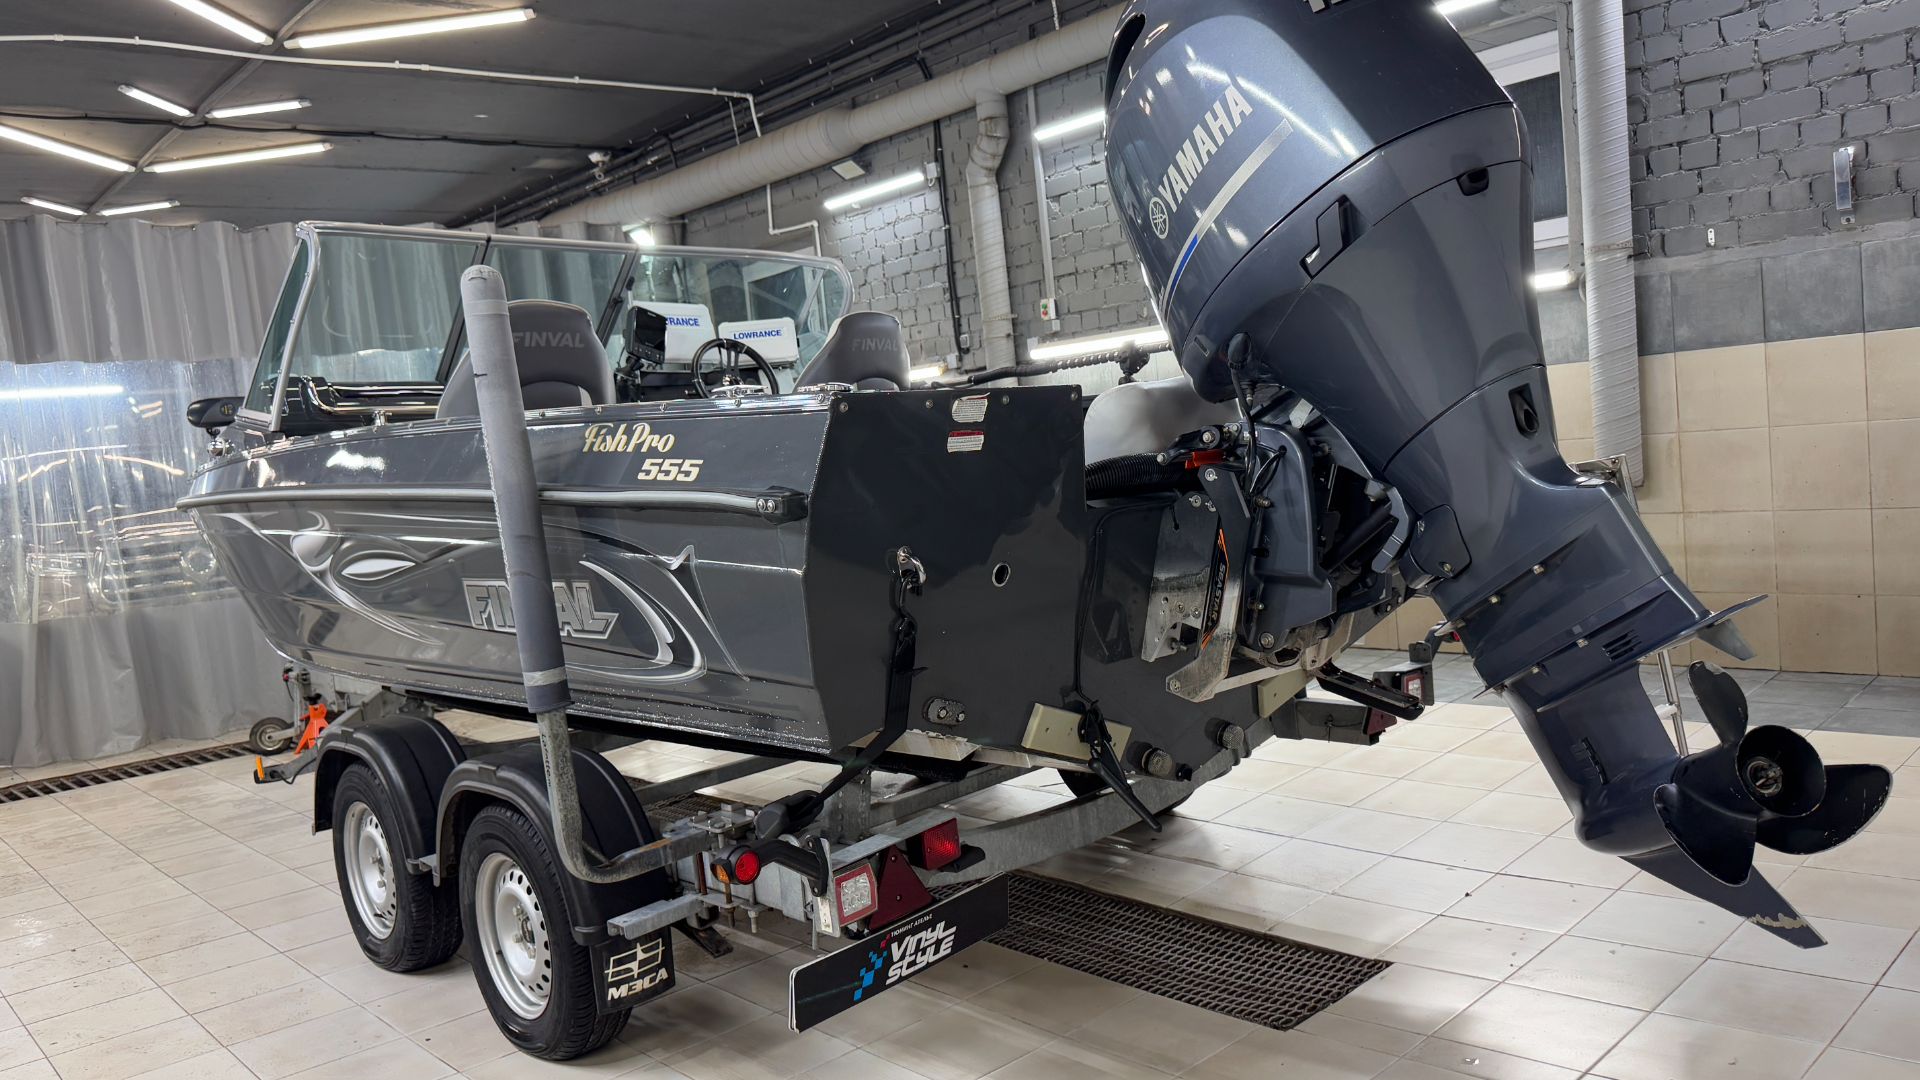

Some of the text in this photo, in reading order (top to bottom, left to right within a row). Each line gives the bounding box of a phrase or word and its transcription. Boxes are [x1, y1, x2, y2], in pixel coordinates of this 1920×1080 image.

[1158, 84, 1253, 213] YAMAHA
[666, 316, 700, 327] RANCE
[733, 325, 782, 340] LOWRANCE
[852, 337, 898, 351] FINVAL
[637, 458, 704, 482] 555
[1211, 563, 1226, 620] SEASTAR
[891, 923, 914, 937] ТЮНИНГ
